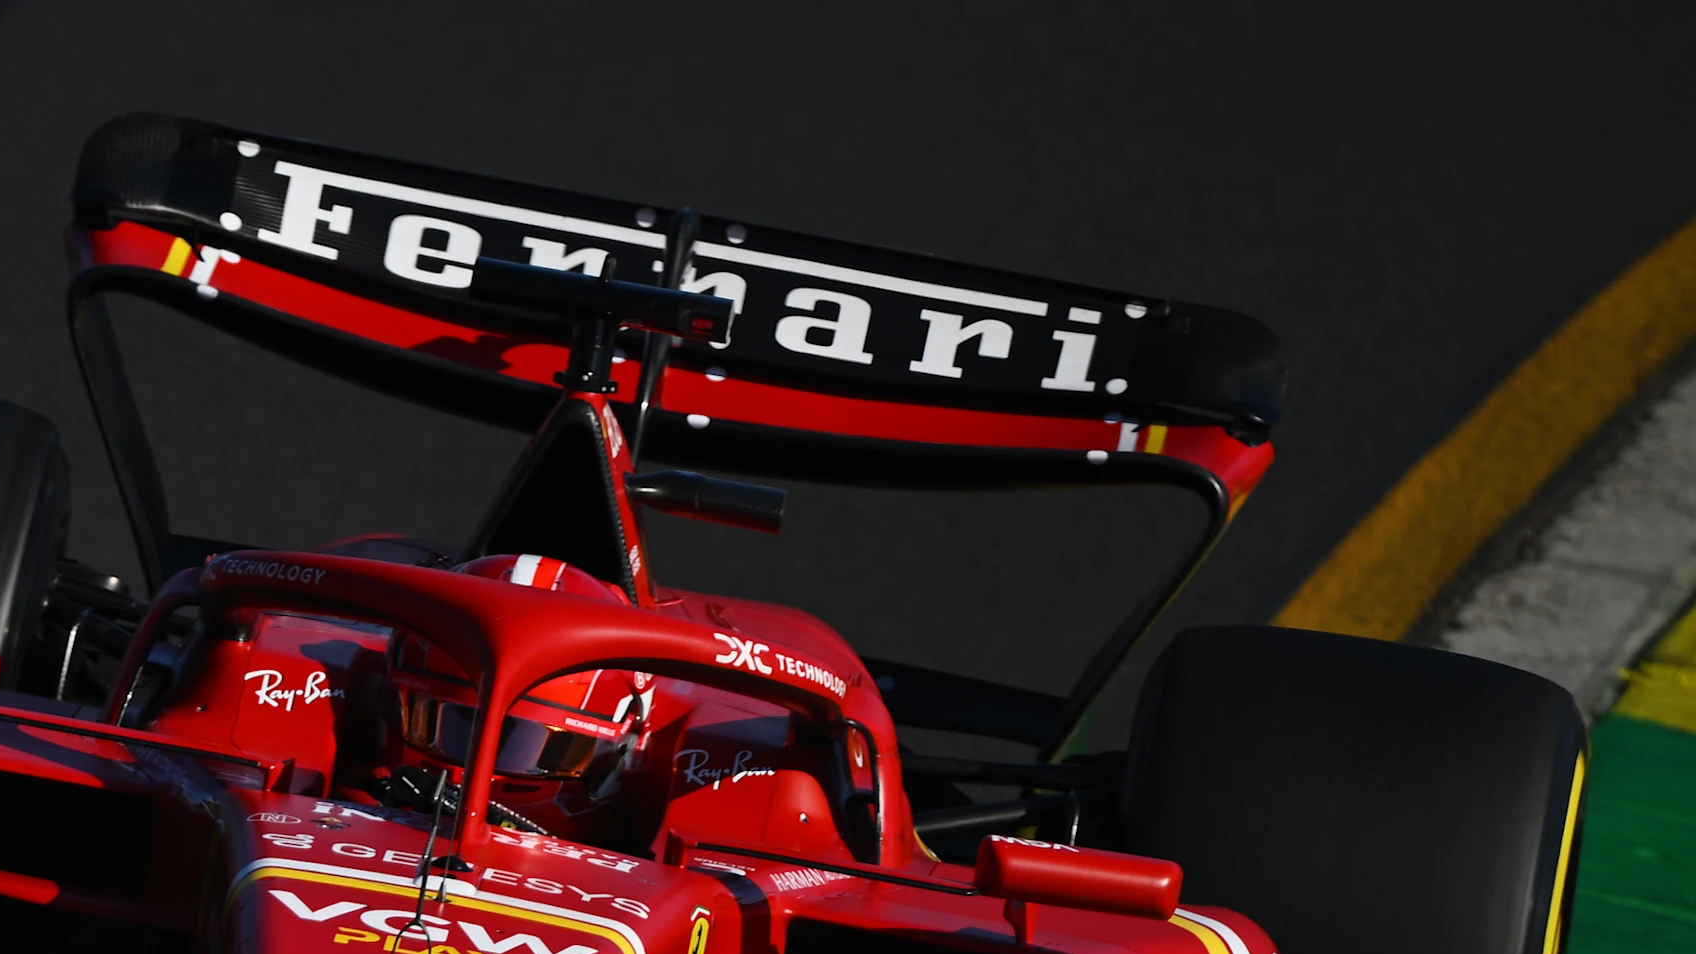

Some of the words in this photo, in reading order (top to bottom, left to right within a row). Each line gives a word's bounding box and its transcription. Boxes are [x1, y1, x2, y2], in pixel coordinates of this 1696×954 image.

[221, 558, 328, 585] TECHNOLOGY
[713, 632, 773, 675] DXC
[331, 842, 651, 920] GEESYS
[769, 867, 826, 892] HARMAN
